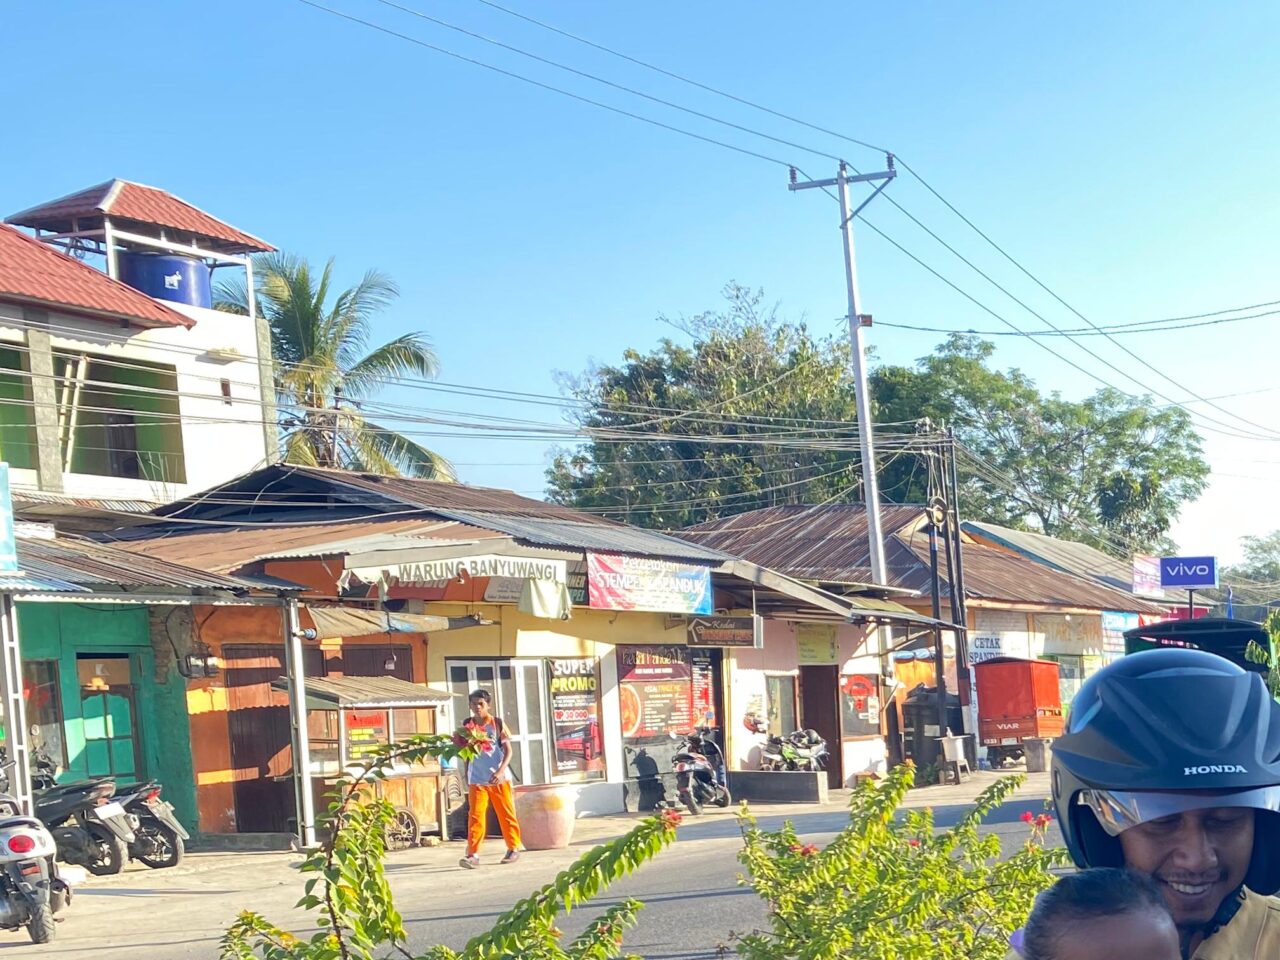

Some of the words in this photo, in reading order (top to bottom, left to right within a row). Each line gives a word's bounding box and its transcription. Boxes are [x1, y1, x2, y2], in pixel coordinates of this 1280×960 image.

[399, 561, 466, 581] WARUNG
[470, 559, 557, 580] BANYUWANGI
[1167, 563, 1209, 576] vivo
[974, 637, 1001, 649] CETAK
[554, 660, 595, 676] SUPER
[551, 676, 597, 692] PROMO
[1184, 765, 1248, 775] HONDA
